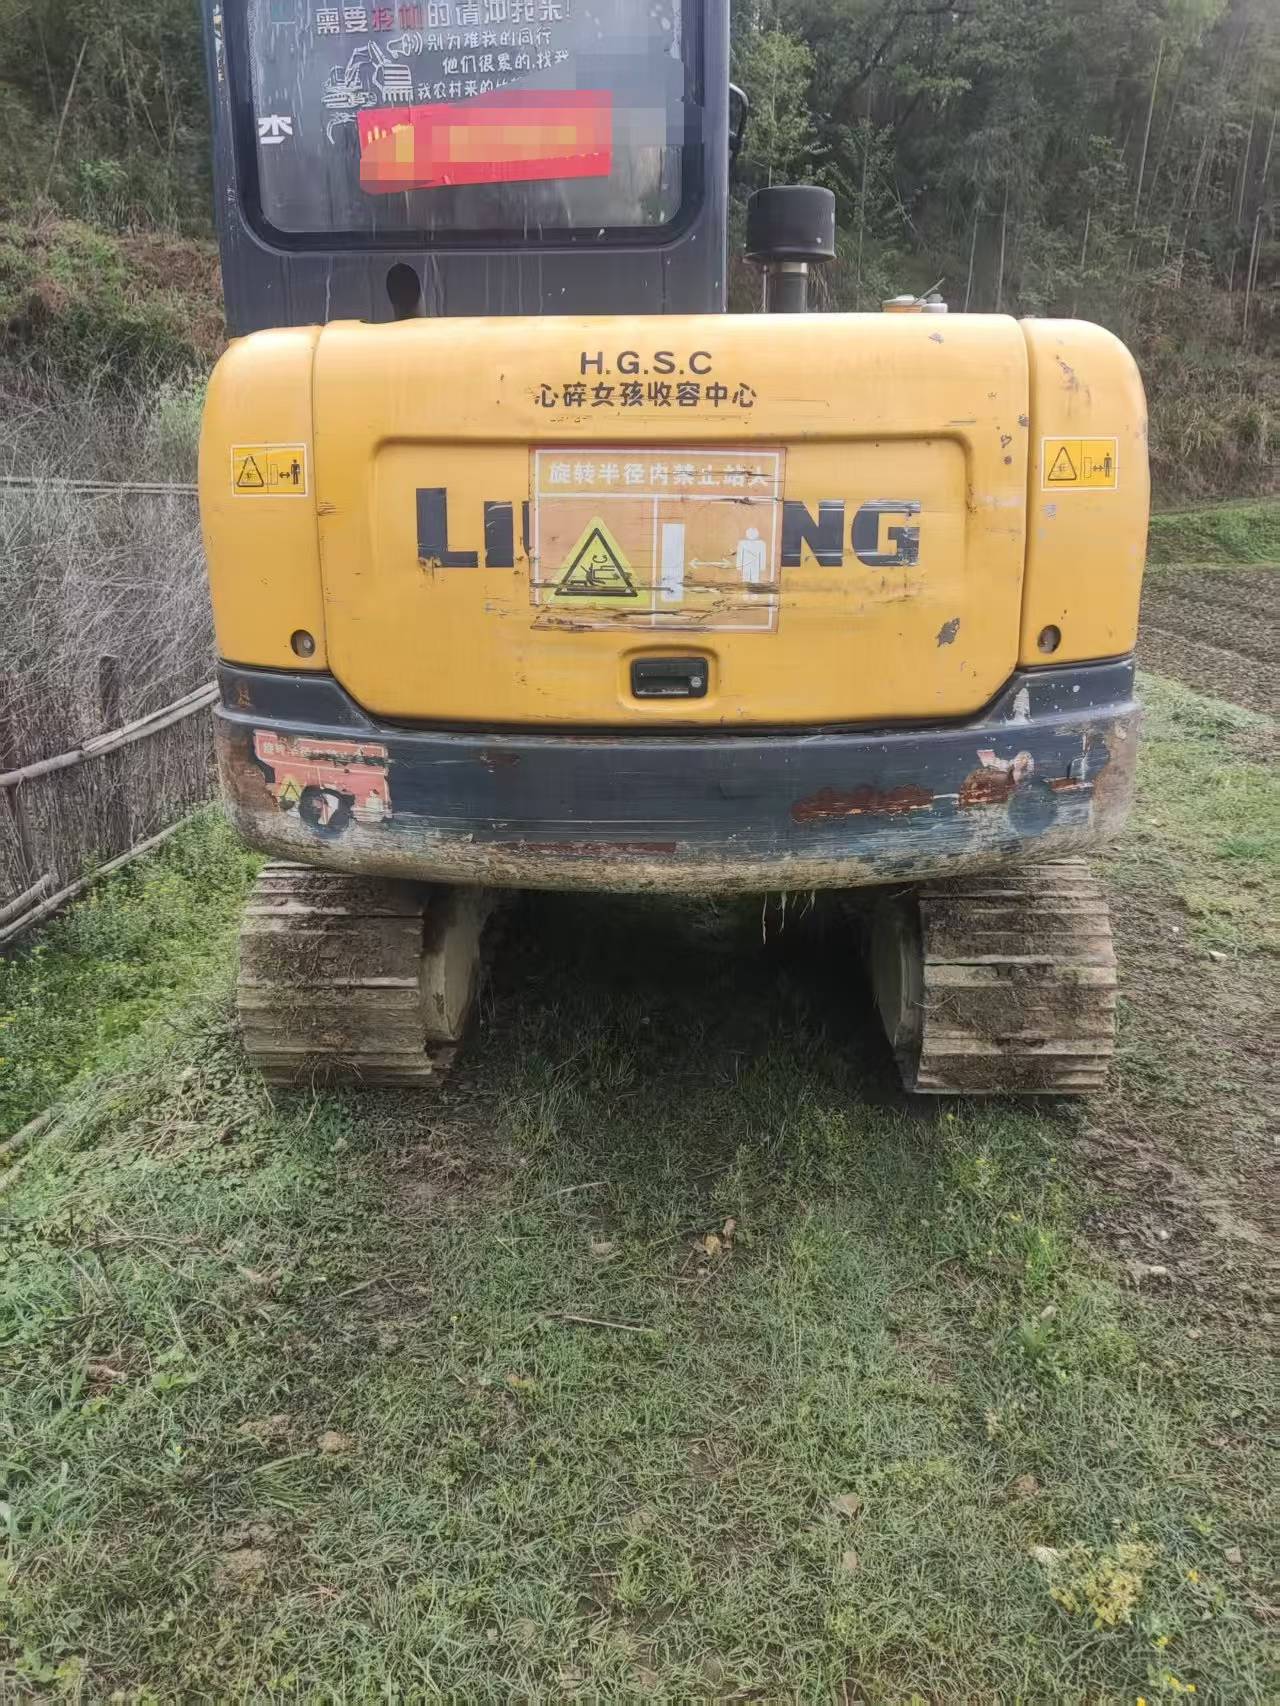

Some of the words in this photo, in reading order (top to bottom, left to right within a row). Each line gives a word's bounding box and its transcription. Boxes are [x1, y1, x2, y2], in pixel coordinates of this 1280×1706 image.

[427, 26, 552, 51] 别为难我的同行
[580, 350, 713, 376] H.G.S.C
[534, 381, 758, 408] 心碎女孩收容中心
[549, 462, 770, 488] 旋转半径内禁止站人
